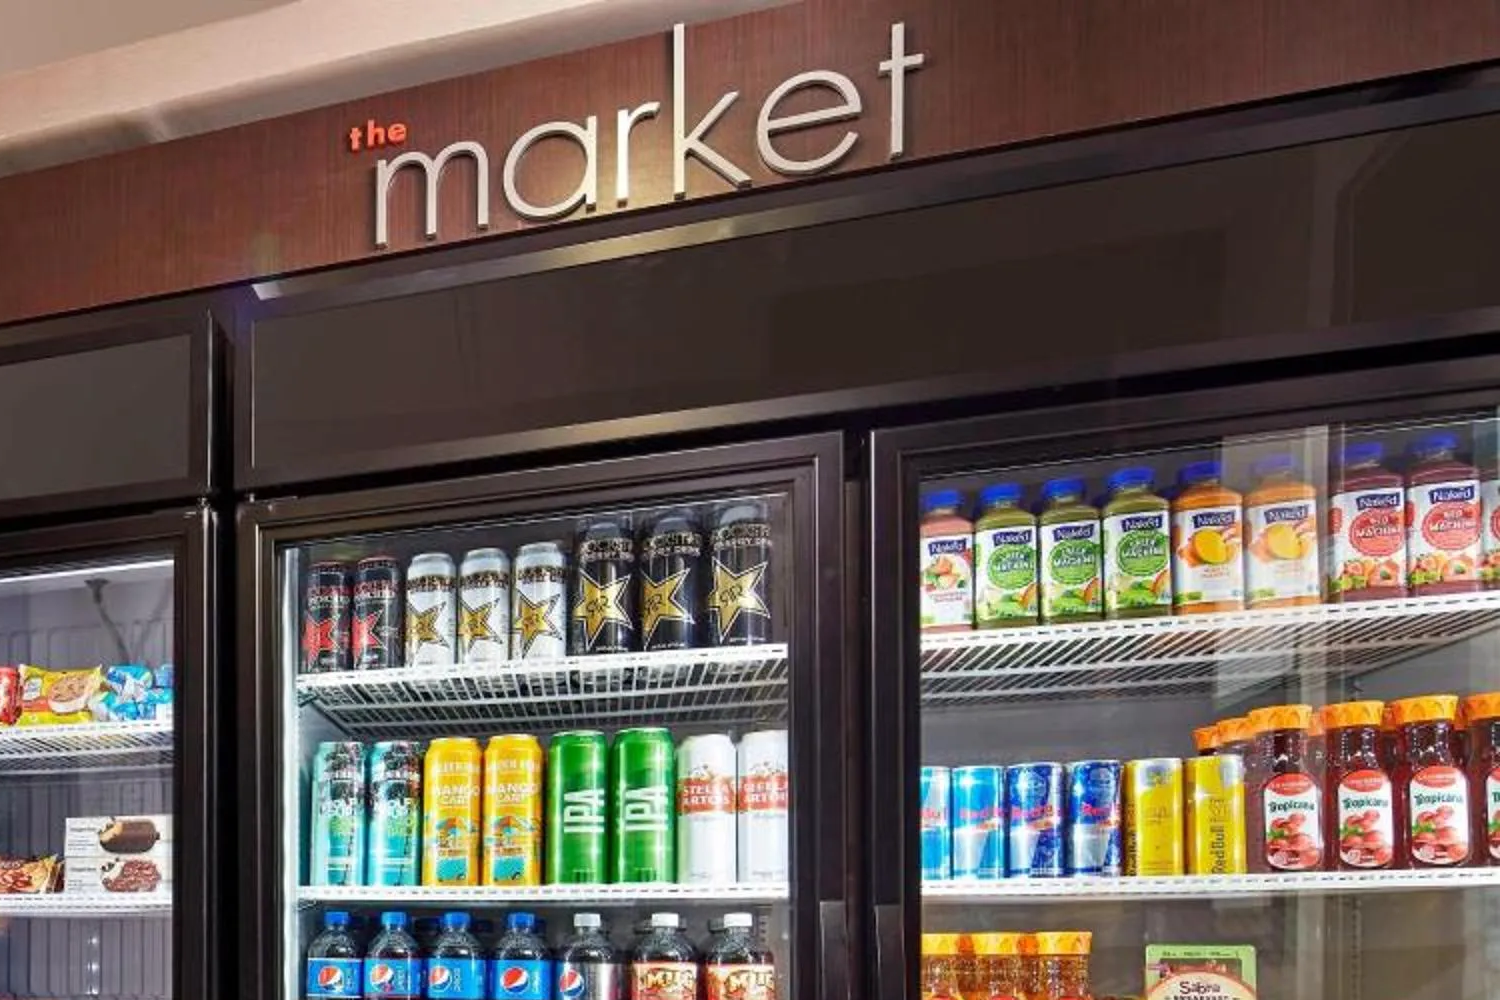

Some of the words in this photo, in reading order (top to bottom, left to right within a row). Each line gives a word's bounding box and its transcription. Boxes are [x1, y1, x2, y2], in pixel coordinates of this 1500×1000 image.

[349, 119, 408, 153] the
[375, 22, 924, 249] market
[1359, 494, 1398, 509] Naked
[1433, 487, 1473, 501] Naked
[563, 788, 605, 834] IPA
[624, 785, 668, 832] IPA
[1267, 800, 1315, 814] Tropicana
[644, 969, 695, 990] MUG
[1179, 980, 1221, 995] Sabra
